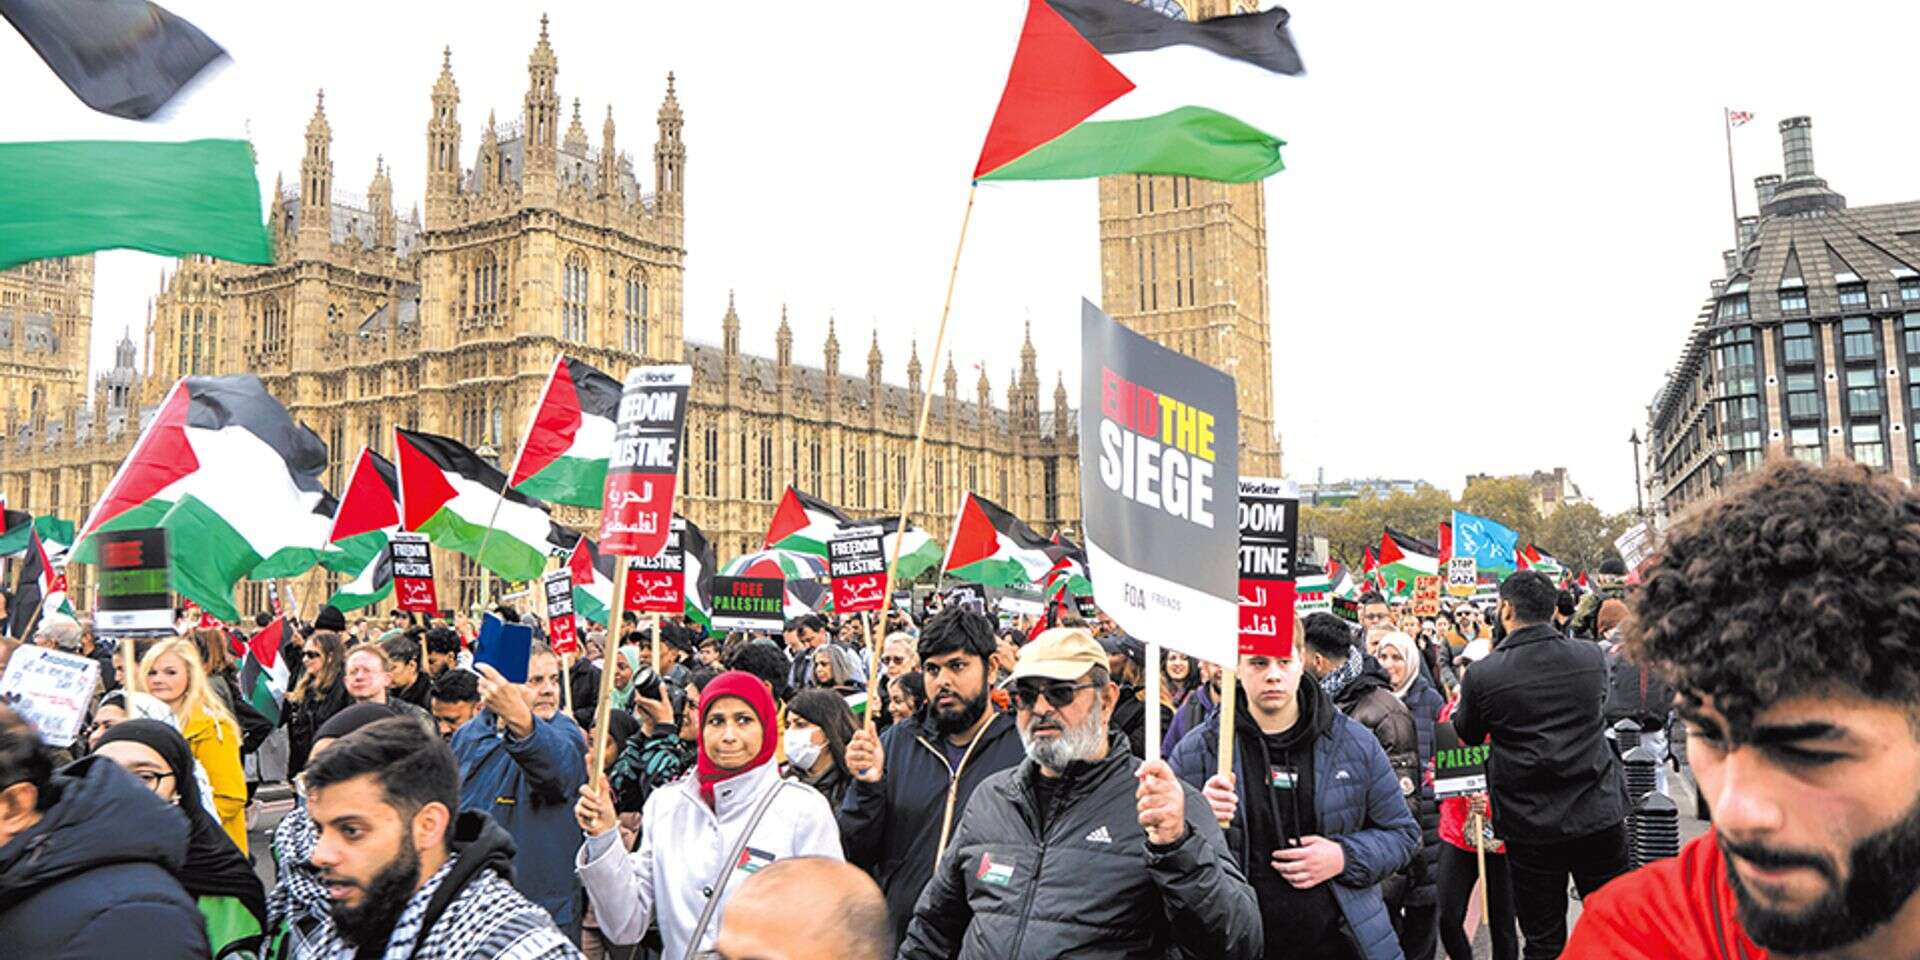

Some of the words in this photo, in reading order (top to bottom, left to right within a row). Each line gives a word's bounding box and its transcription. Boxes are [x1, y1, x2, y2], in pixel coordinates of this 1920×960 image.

[1100, 418, 1215, 529] SIEGE
[1239, 481, 1281, 495] Worker
[831, 538, 880, 557] FREEDOM
[832, 558, 884, 577] PALESTINE
[732, 581, 764, 598] FREE
[1450, 575, 1475, 585] GAZA
[713, 595, 782, 613] PALESTINE
[1124, 582, 1146, 611] FOA
[1437, 744, 1490, 770] PALEST
